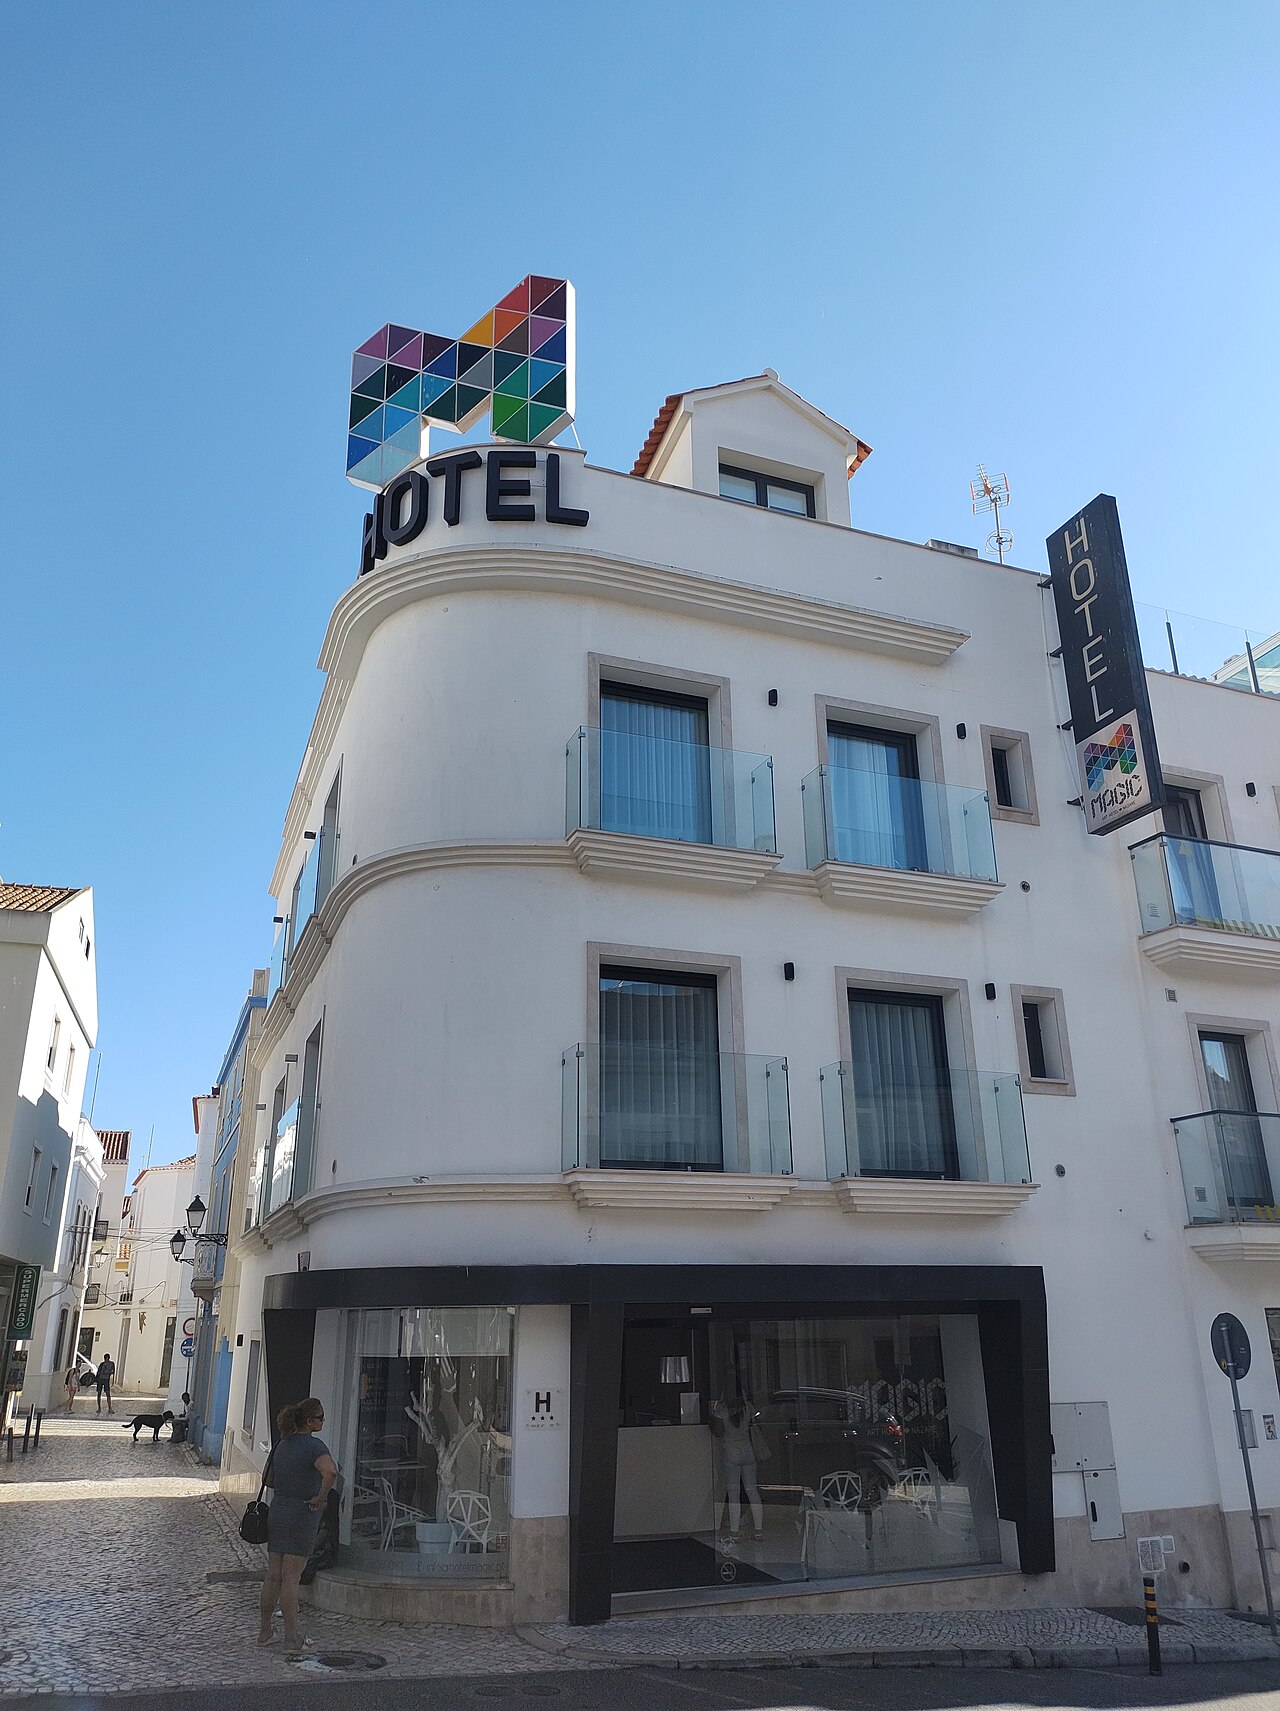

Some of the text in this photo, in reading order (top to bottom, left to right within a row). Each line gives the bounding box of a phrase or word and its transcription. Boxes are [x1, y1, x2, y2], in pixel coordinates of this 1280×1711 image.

[359, 450, 589, 576] HOTEL
[1063, 516, 1114, 723] HOTEL
[1091, 774, 1142, 819] MAGIC
[16, 1269, 33, 1327] SUPERMERCADO
[535, 1391, 551, 1413] H
[847, 1377, 949, 1424] MAGIC
[866, 1427, 880, 1437] ART
